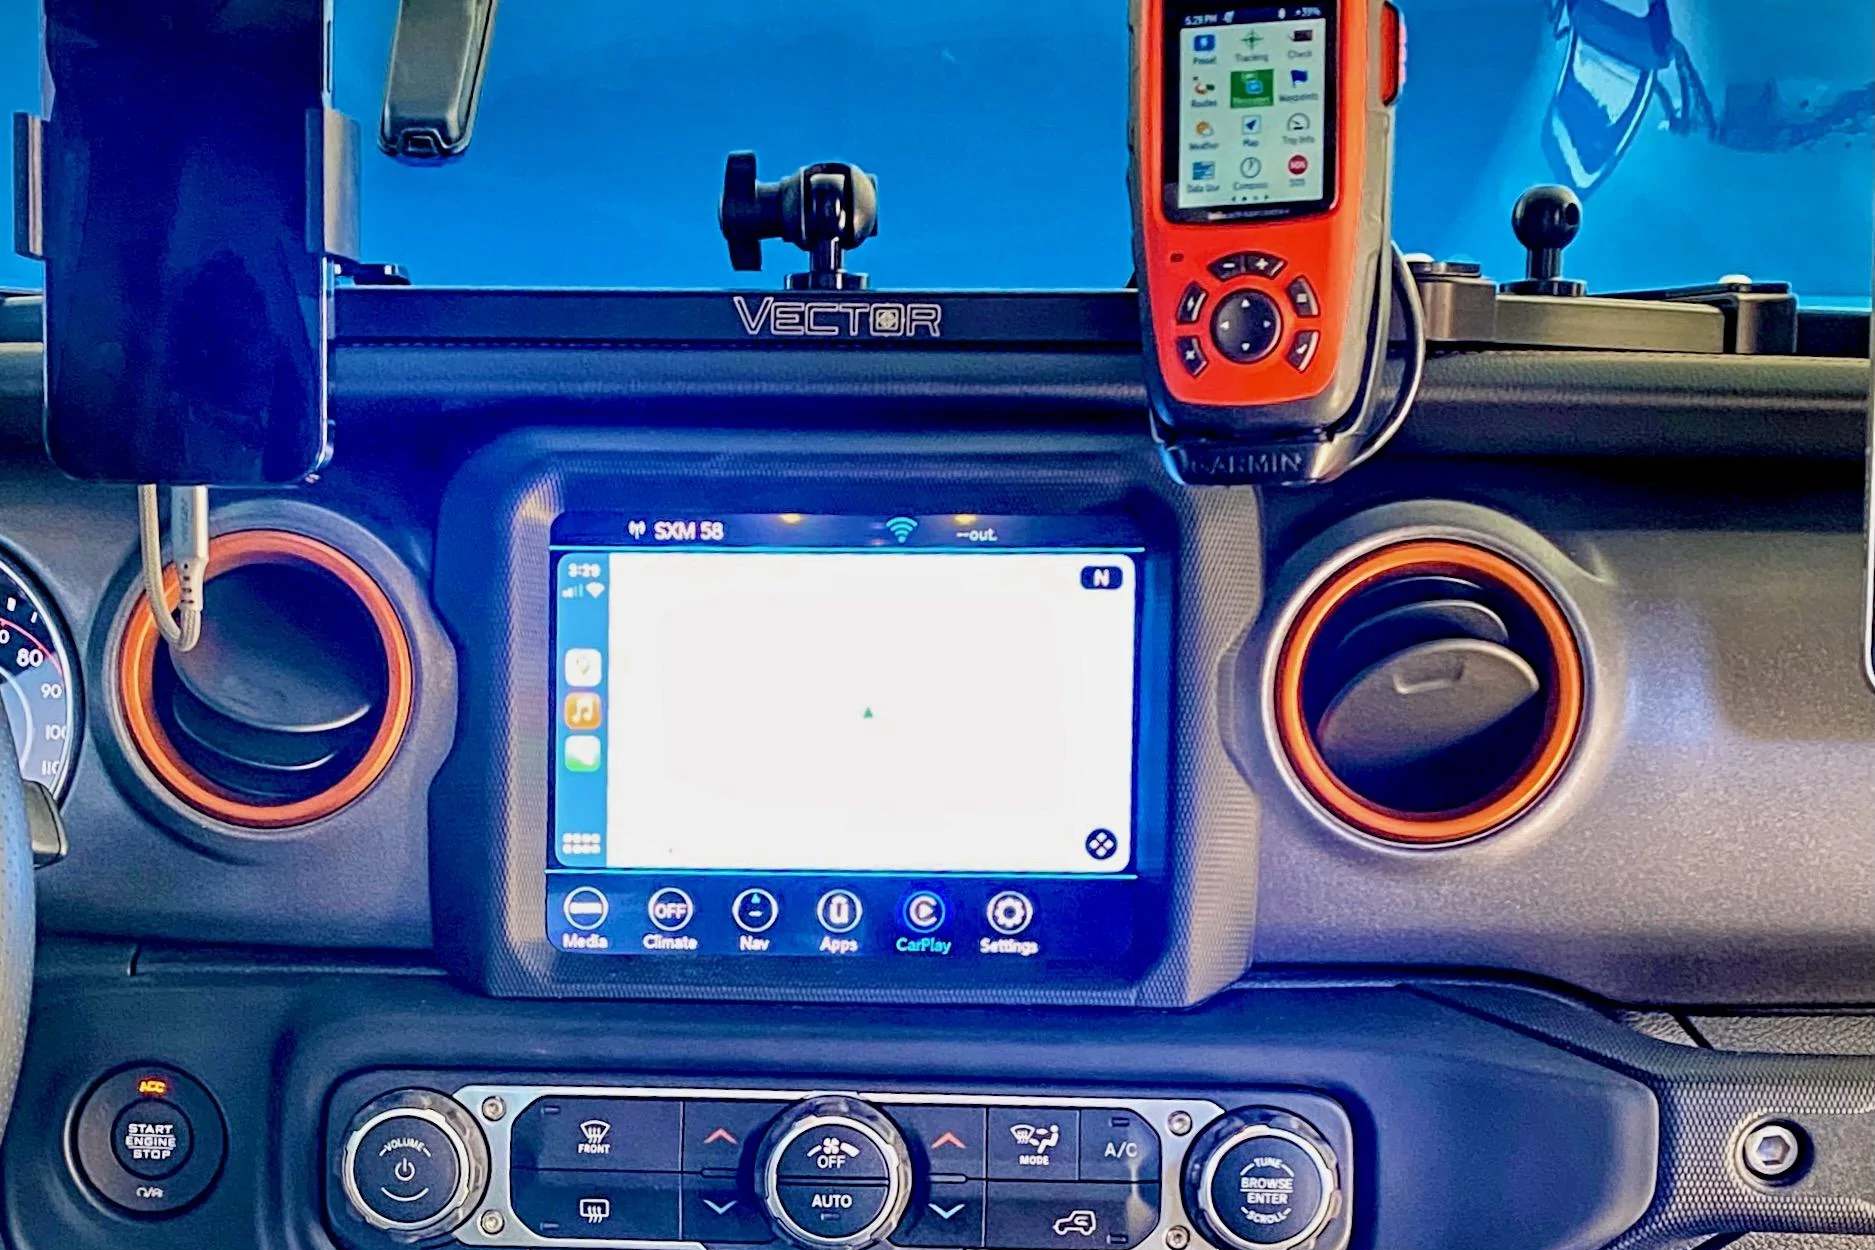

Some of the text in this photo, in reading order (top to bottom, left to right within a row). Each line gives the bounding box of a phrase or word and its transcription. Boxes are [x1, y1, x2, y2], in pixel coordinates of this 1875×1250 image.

[732, 296, 942, 337] VECTOR
[1191, 451, 1303, 475] GARMIN
[654, 520, 725, 541] SXM 58
[1093, 568, 1110, 587] N
[0, 629, 10, 645] 0
[16, 647, 44, 667] 80
[40, 683, 62, 699] 90
[654, 903, 688, 920] OFF
[562, 932, 609, 949] Media
[642, 933, 698, 950] Climate
[739, 934, 771, 951] Nav
[819, 935, 859, 954] Apps
[896, 936, 952, 955] CarPlay
[979, 937, 1039, 957] Settings
[138, 1080, 167, 1093] ACC
[128, 1123, 174, 1134] START
[125, 1136, 177, 1147] ENGINE
[383, 1136, 425, 1152] VOLUME
[577, 1143, 611, 1154] FRONT
[133, 1149, 171, 1160] STOP
[1104, 1142, 1138, 1158] A/C
[816, 1155, 846, 1169] OFF
[1019, 1155, 1050, 1166] MODE
[1253, 1156, 1283, 1169] TUNE
[1240, 1177, 1293, 1189] BROWSE
[811, 1194, 853, 1208] AUTO
[1246, 1192, 1288, 1204] ENTER
[1246, 1210, 1288, 1224] SCROLL
